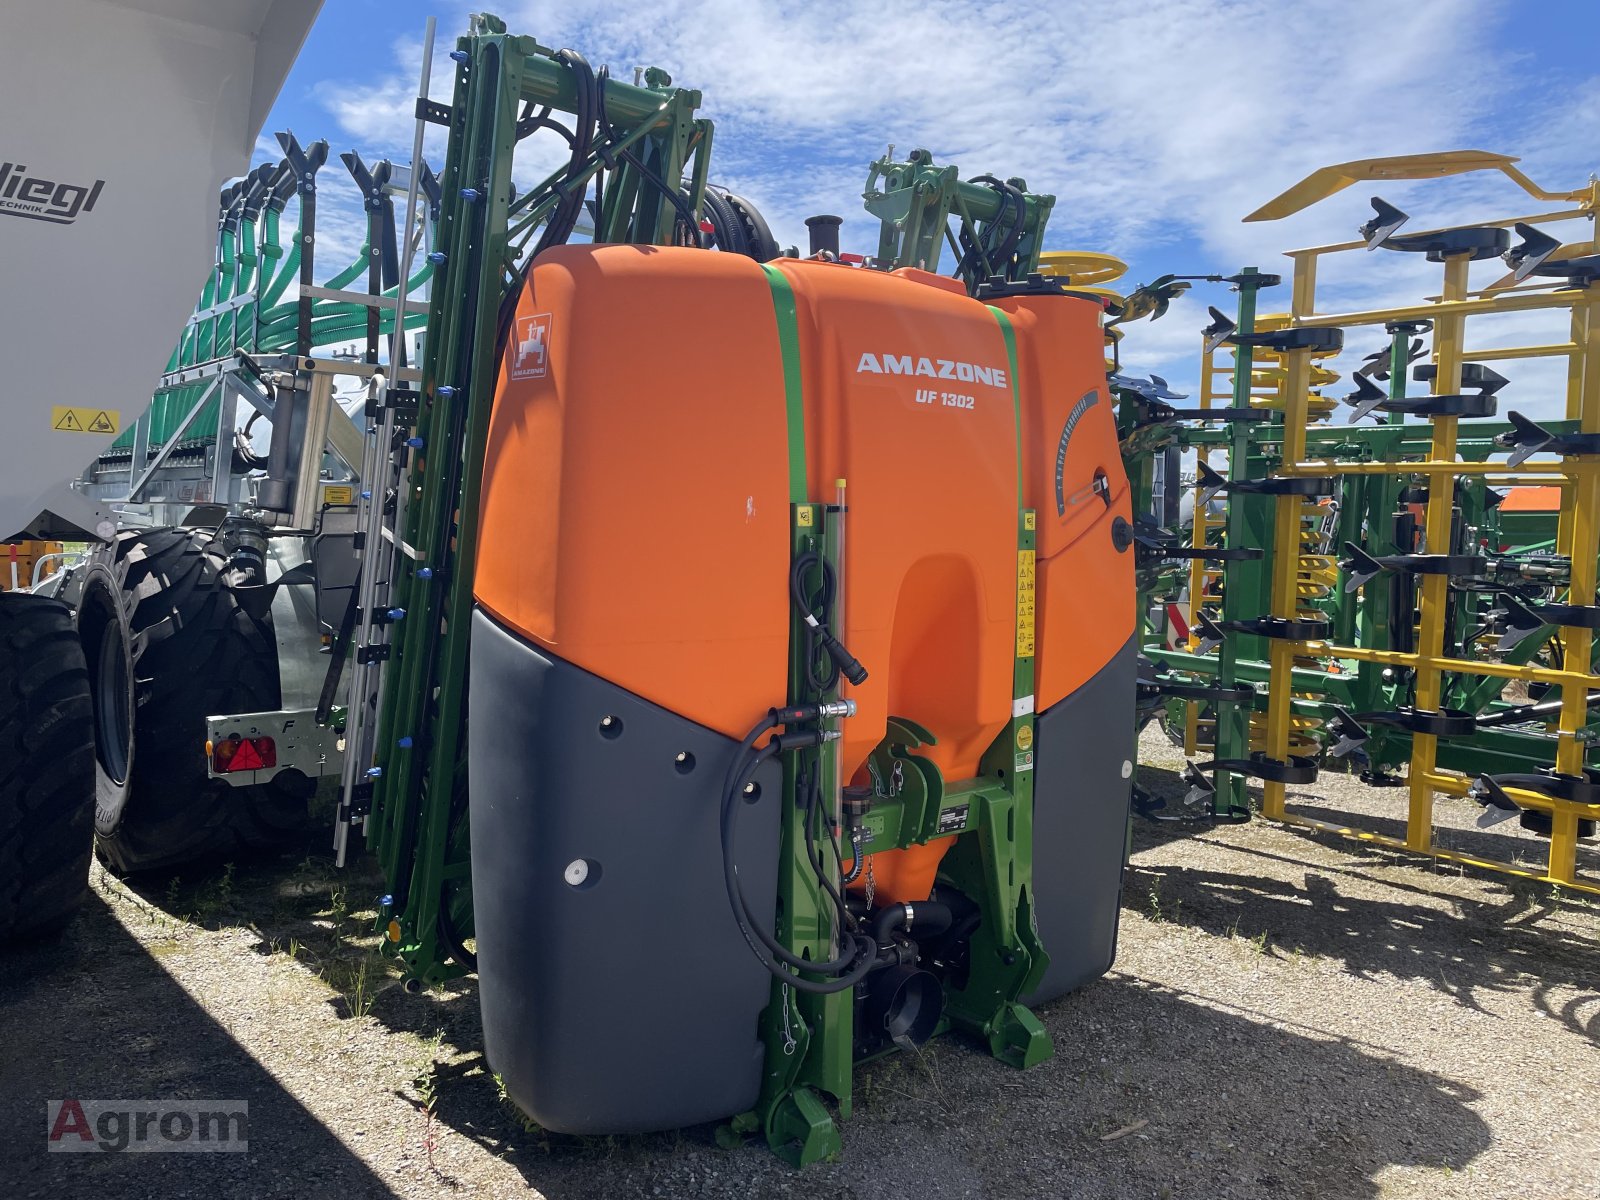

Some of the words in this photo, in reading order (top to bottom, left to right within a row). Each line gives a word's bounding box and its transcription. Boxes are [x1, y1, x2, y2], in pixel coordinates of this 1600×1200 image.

[513, 367, 545, 377] AMAZONE
[857, 353, 1007, 388] AMAZONE
[915, 389, 937, 405] UF
[941, 392, 975, 410] 1302
